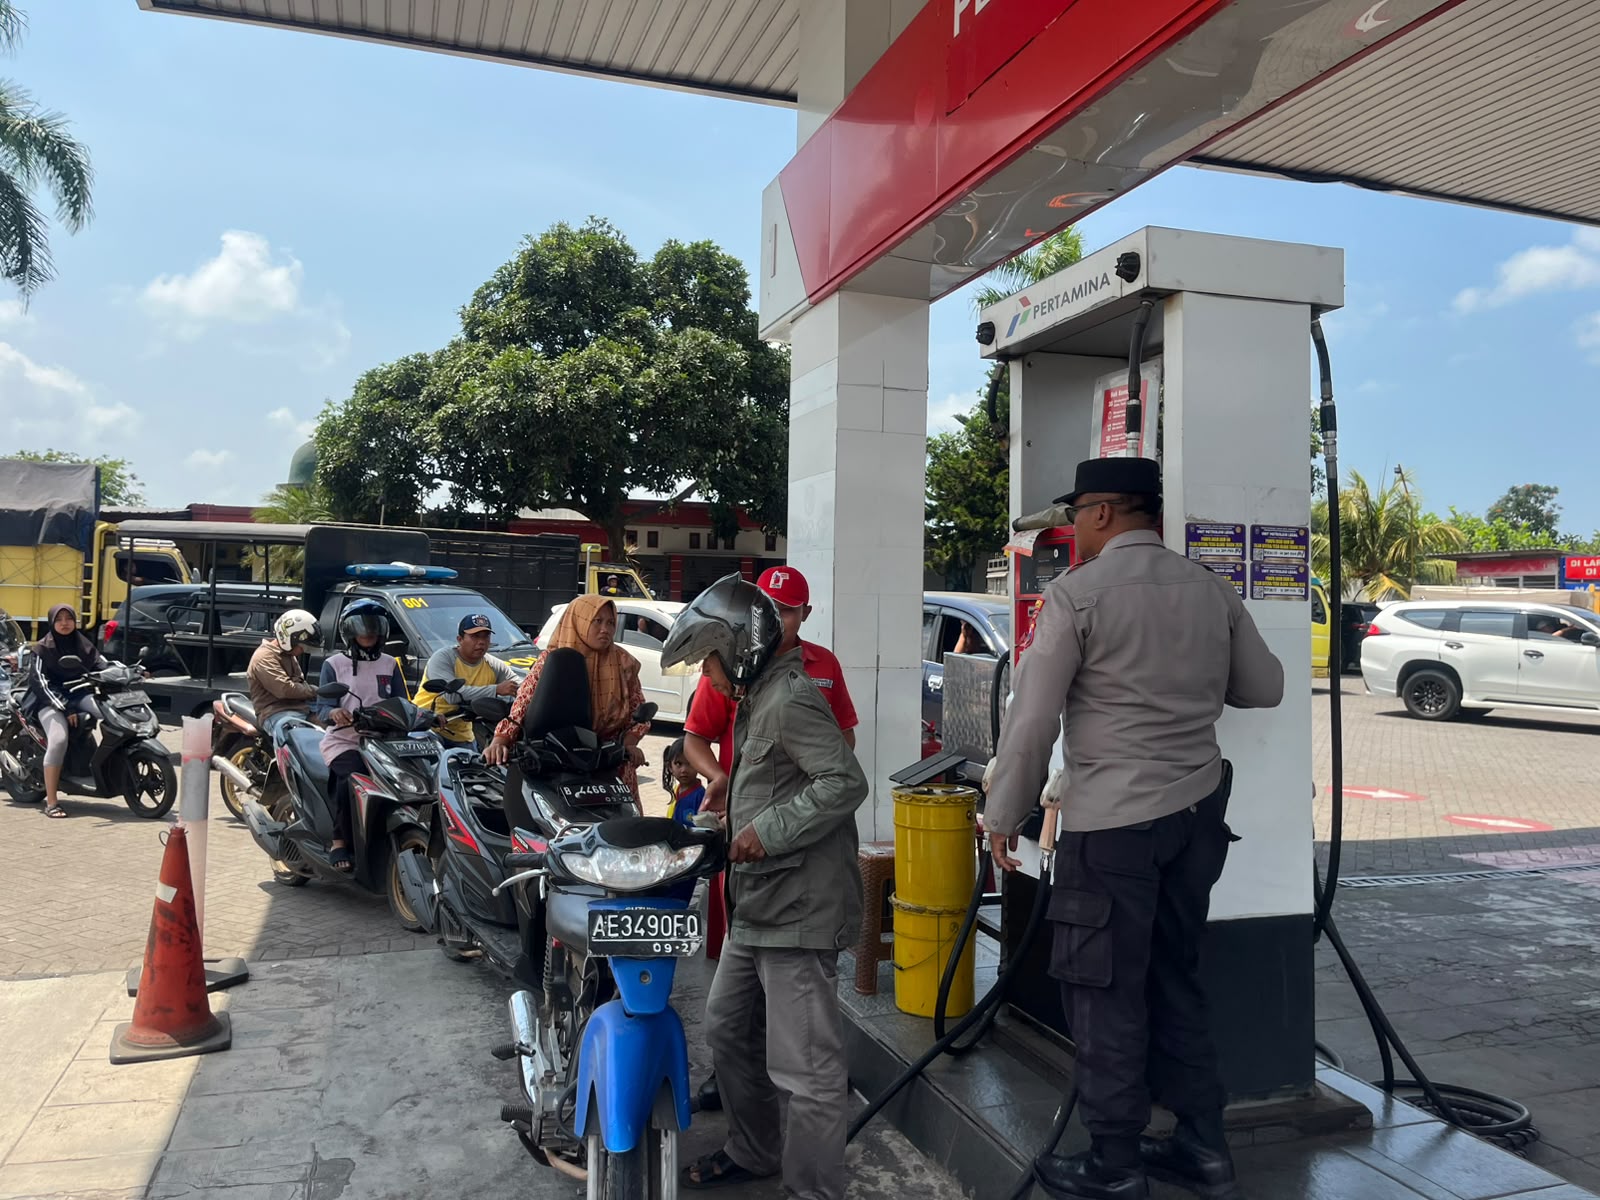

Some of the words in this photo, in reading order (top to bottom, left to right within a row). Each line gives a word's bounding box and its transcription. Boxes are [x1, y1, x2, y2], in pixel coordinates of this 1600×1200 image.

[1033, 272, 1111, 320] PERTAMINA
[402, 597, 429, 609] 801
[751, 605, 764, 653] VIPER
[563, 786, 572, 796] B
